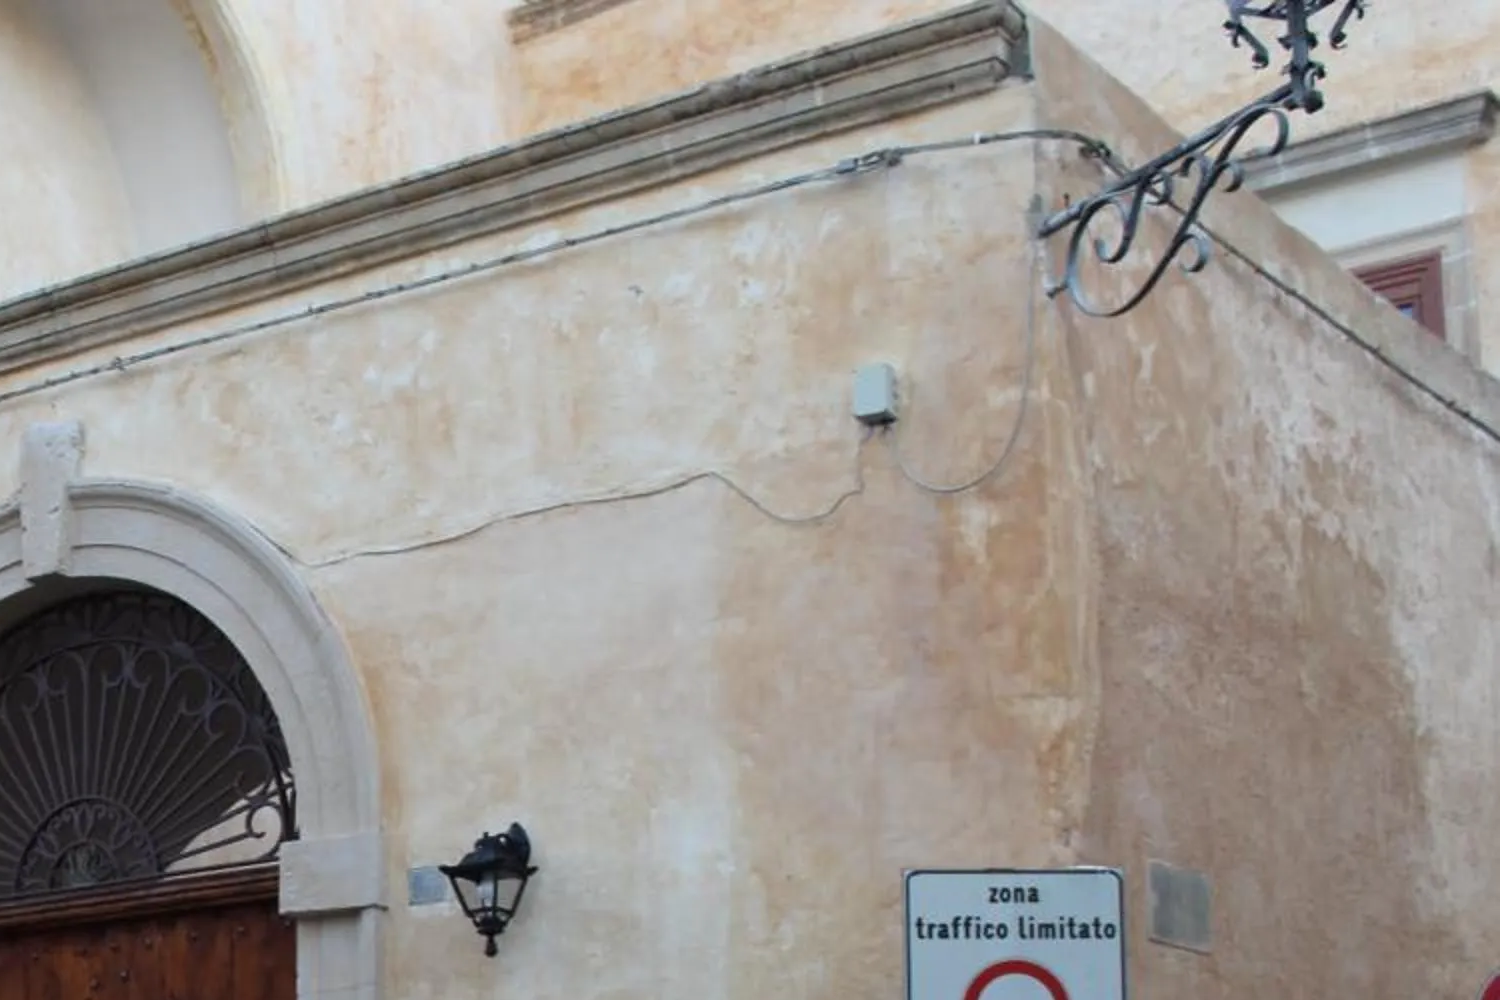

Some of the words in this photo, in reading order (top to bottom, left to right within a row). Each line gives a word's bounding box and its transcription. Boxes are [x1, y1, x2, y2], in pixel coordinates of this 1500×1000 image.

[988, 886, 1041, 904] zona
[915, 916, 1009, 940] traffico
[1017, 916, 1117, 940] limitato
